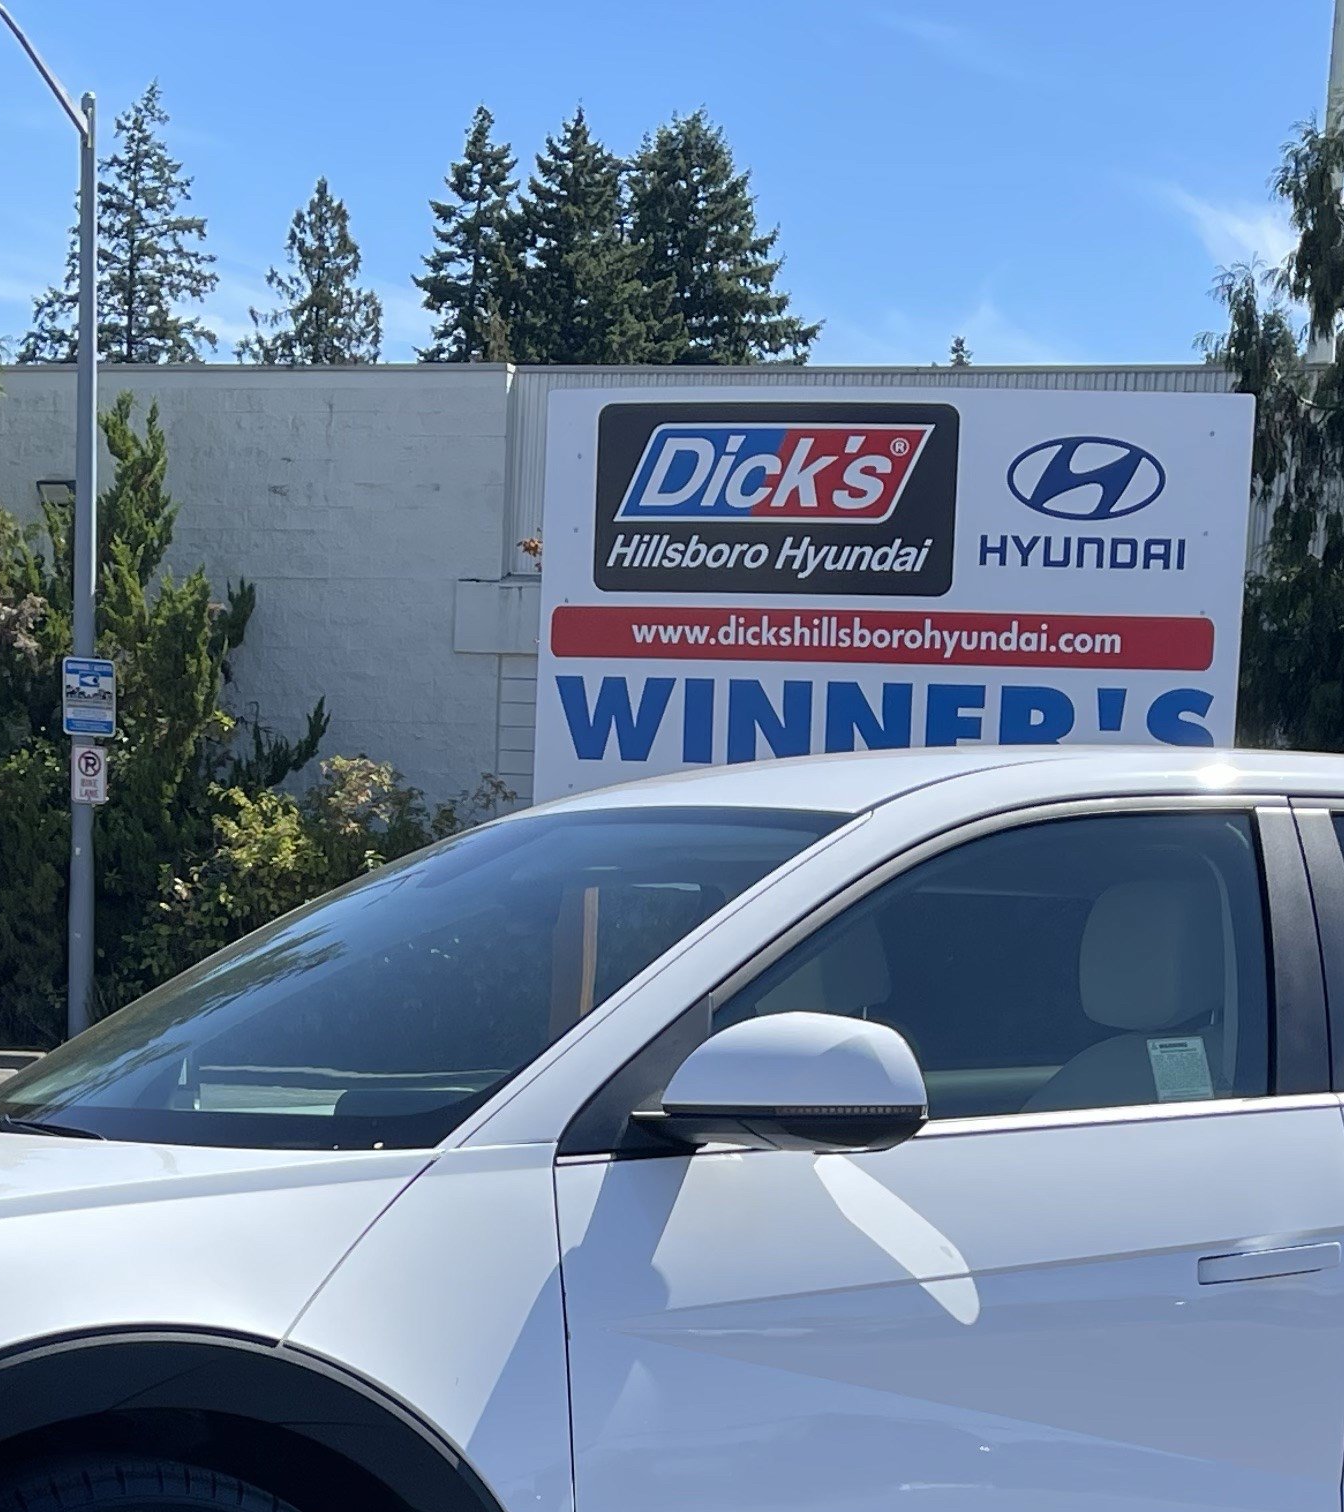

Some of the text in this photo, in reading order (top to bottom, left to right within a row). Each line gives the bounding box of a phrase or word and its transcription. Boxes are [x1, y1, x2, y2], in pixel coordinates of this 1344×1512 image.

[607, 534, 934, 579] Hillsboro Hyundai
[979, 534, 1186, 570] HYUNDAI
[632, 615, 1122, 658] www.dickshillsborohyundai.com
[556, 675, 1215, 765] WINNER'S
